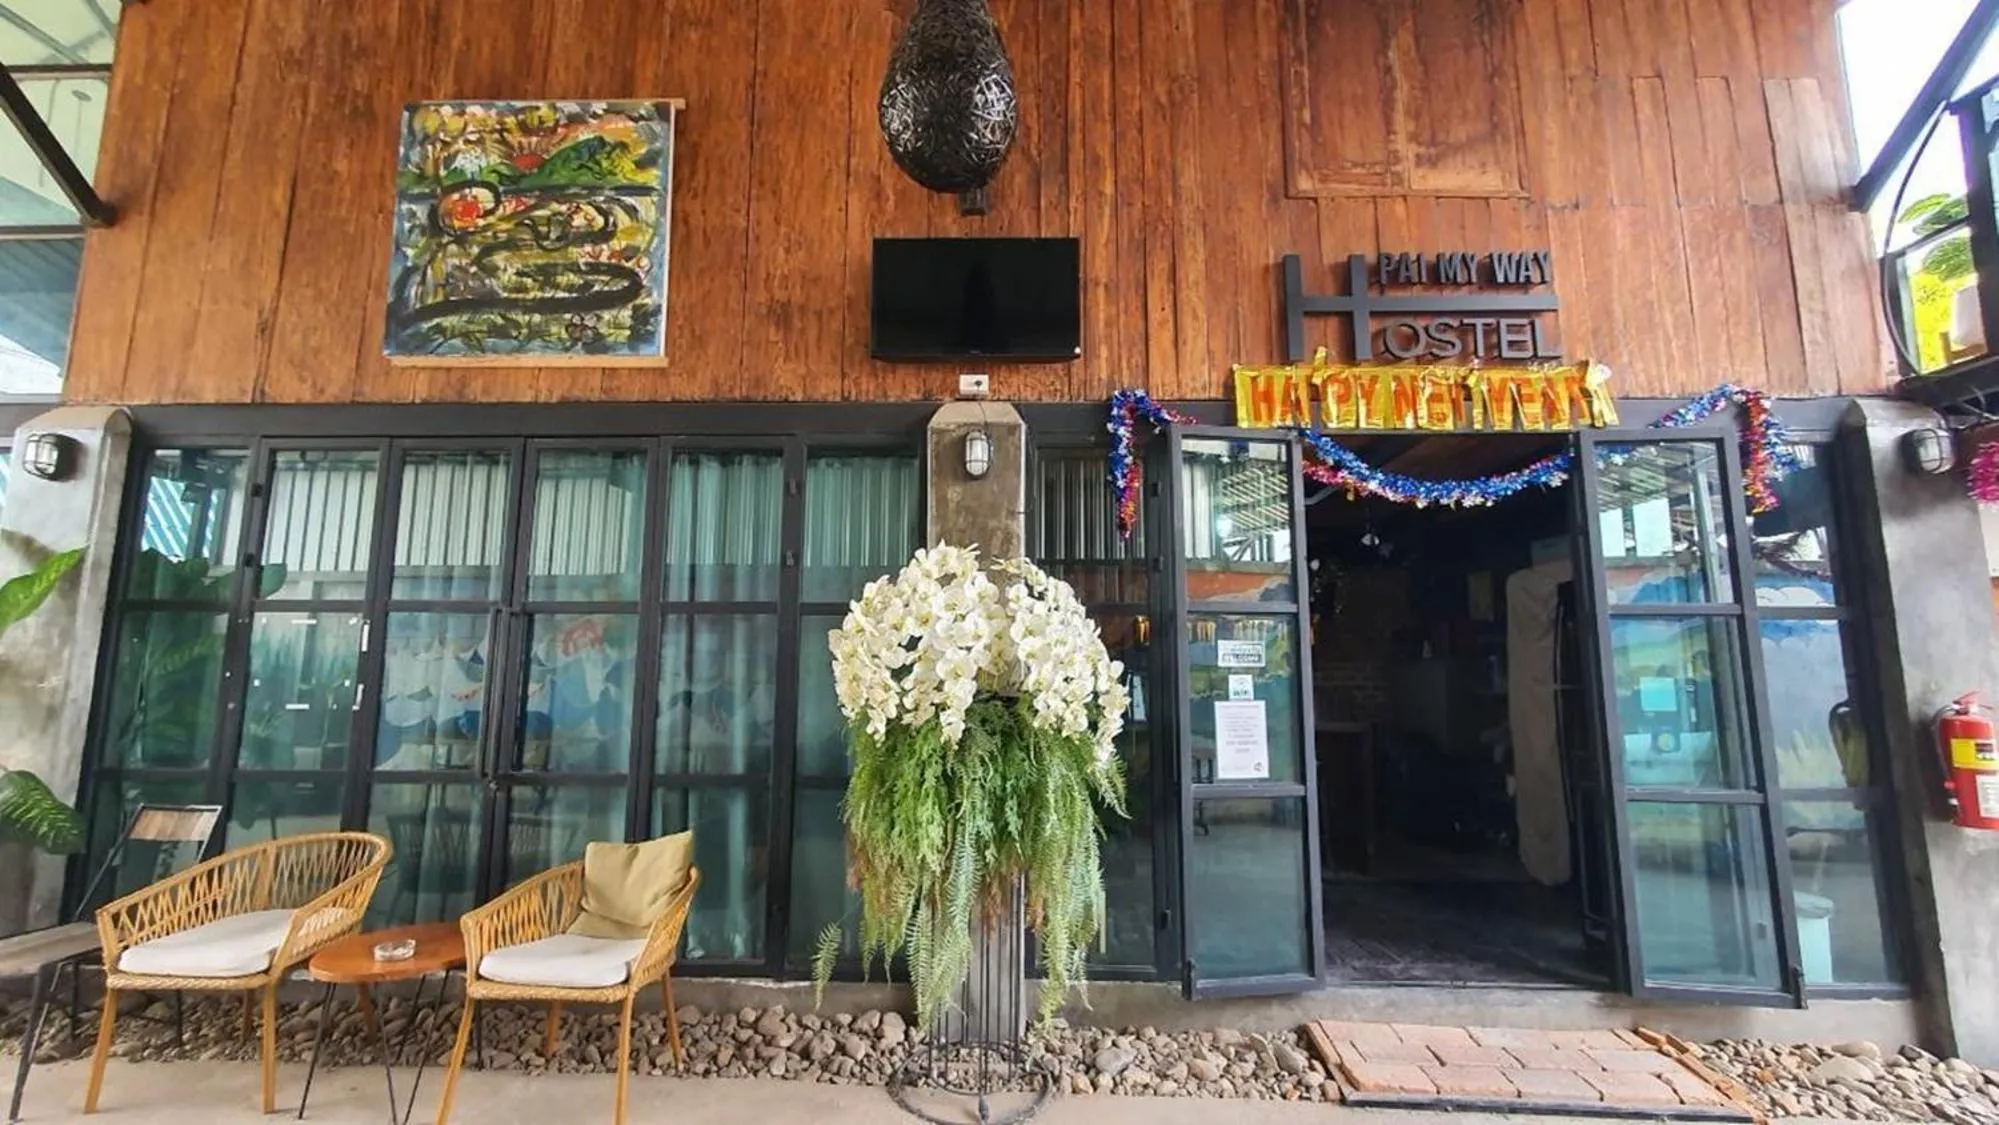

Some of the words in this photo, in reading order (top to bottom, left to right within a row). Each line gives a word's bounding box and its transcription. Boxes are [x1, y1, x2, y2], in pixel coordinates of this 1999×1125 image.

[1379, 252, 1428, 285] PAI
[1436, 252, 1478, 285] MY
[1490, 251, 1550, 285] WAY
[1283, 253, 1563, 361] HOSTEL
[1248, 372, 1383, 427] HAPY
